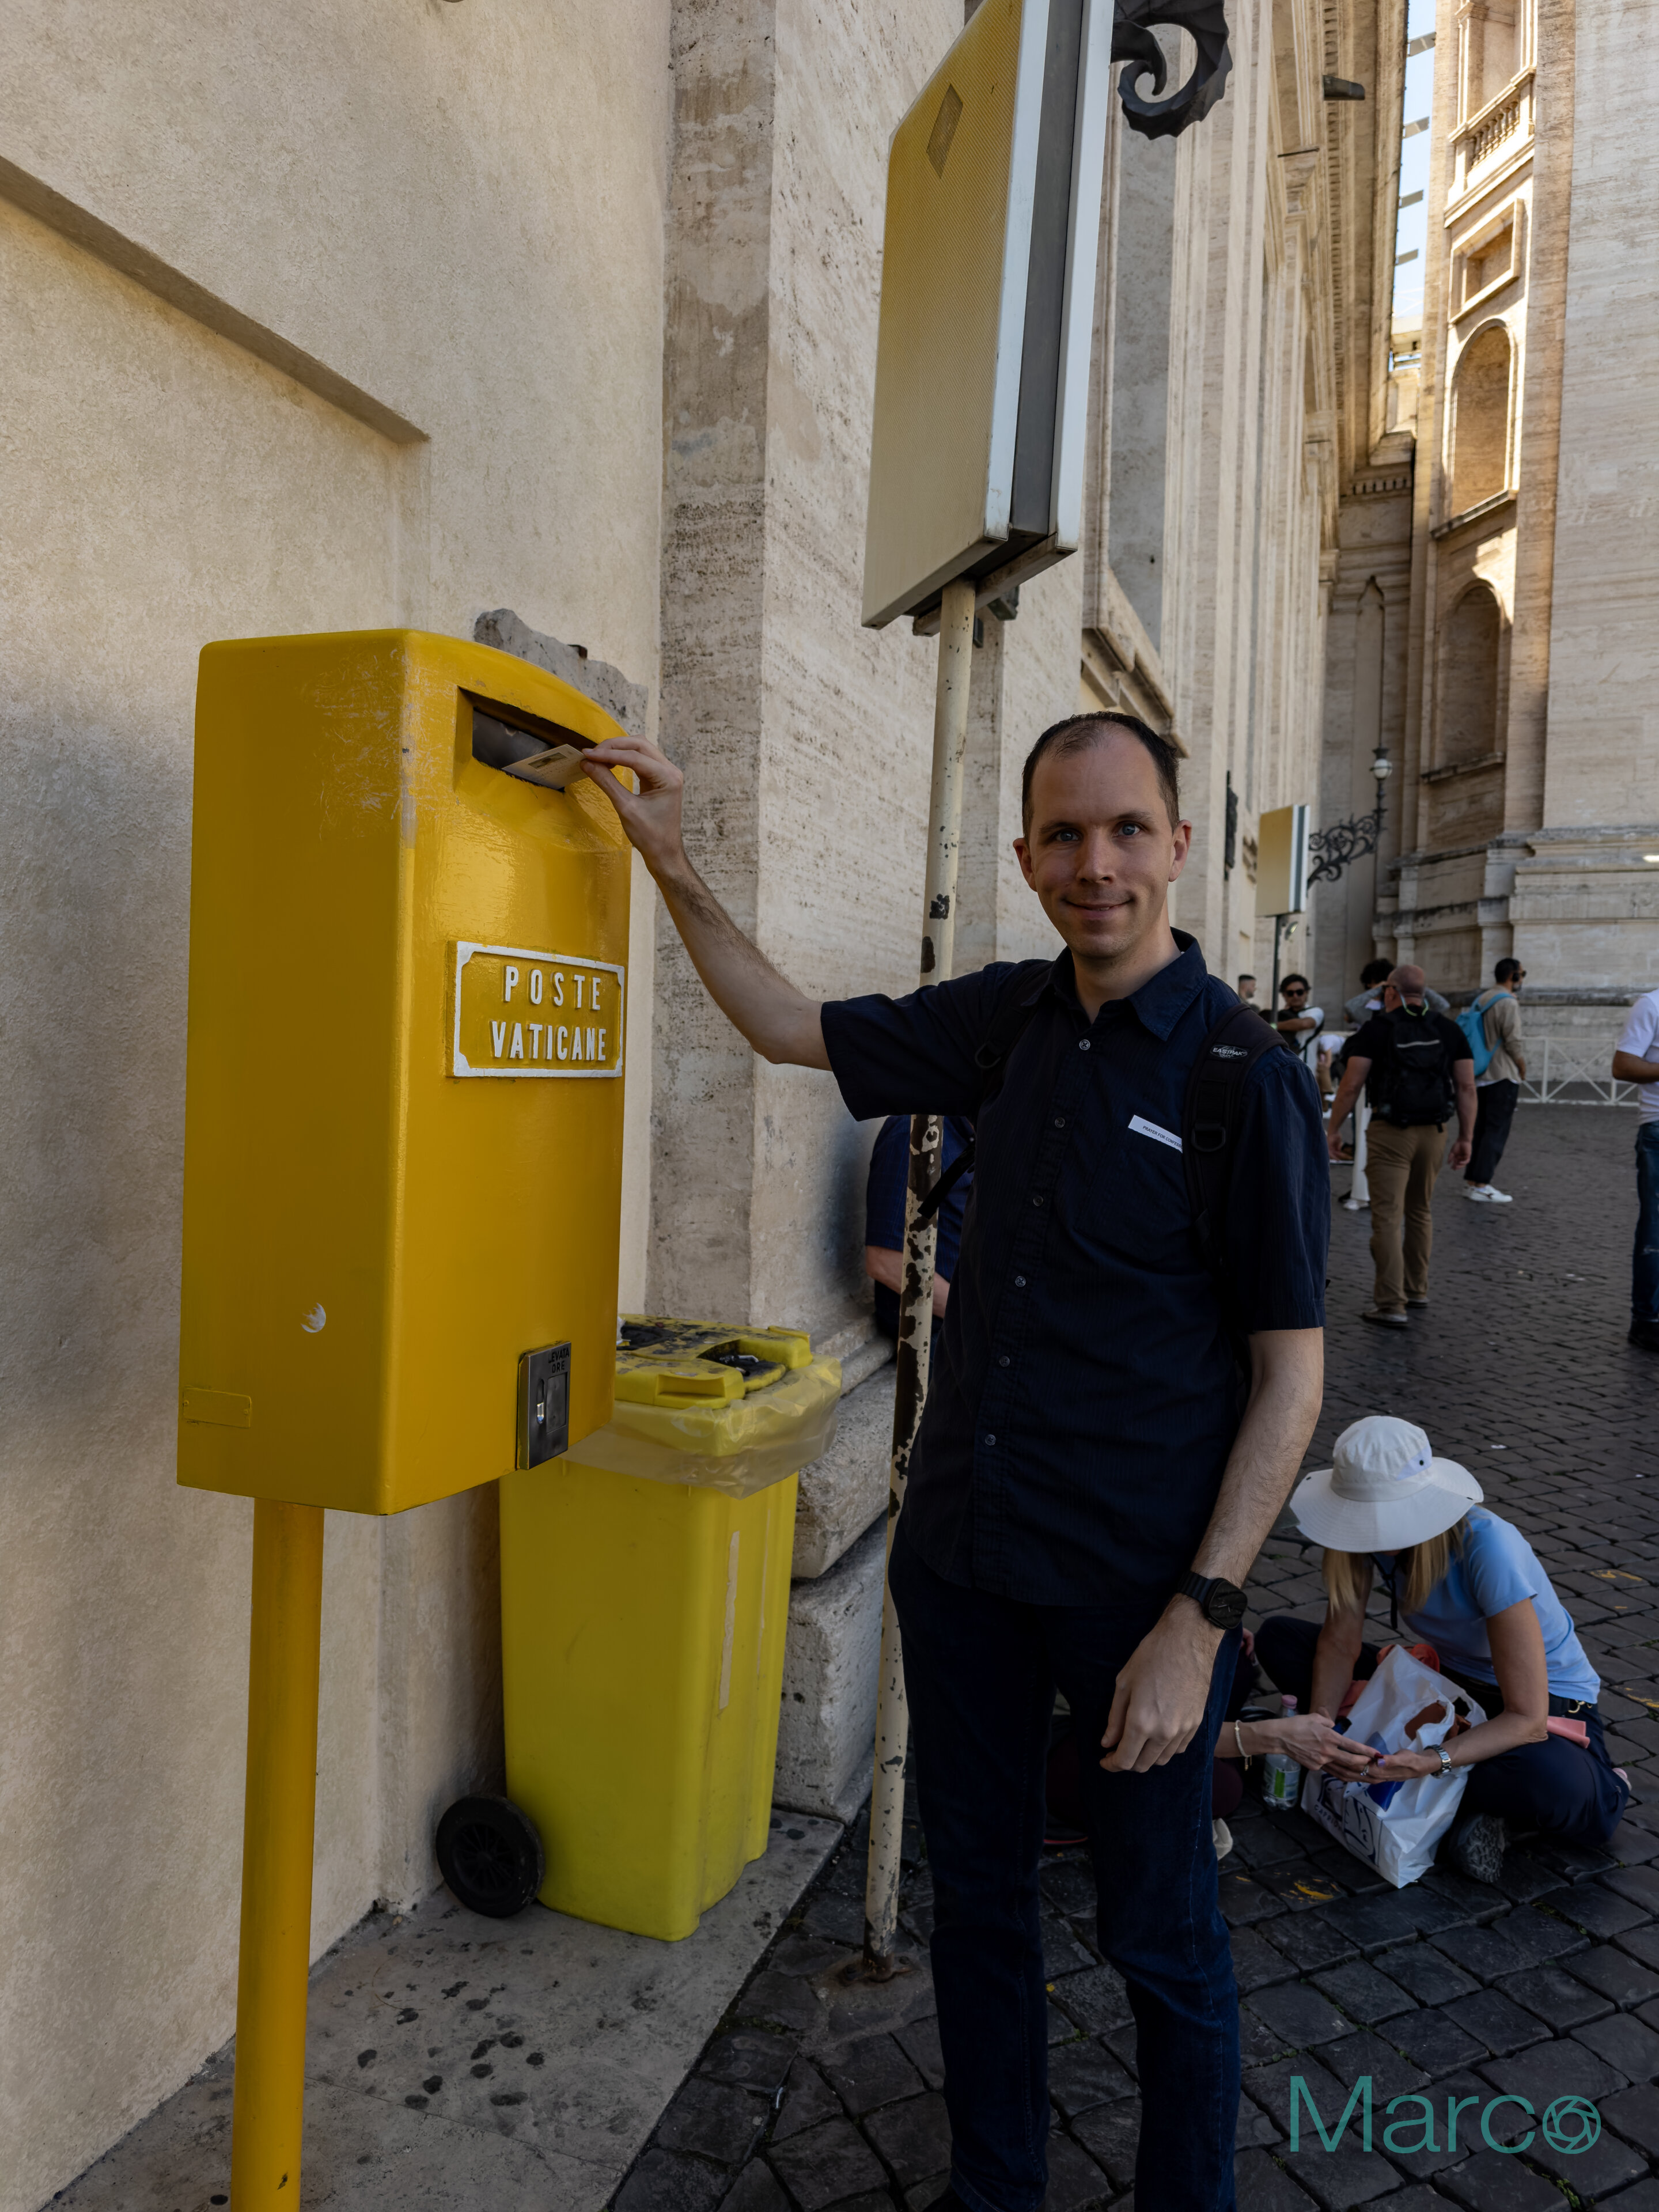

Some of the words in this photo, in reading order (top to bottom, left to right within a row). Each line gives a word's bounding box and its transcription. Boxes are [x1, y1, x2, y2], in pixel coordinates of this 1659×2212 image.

[505, 965, 601, 1010] POSTE
[491, 1021, 607, 1061] VATICANE
[1212, 1047, 1243, 1056] EASTPAK
[1142, 1126, 1158, 1136] PRAYER
[548, 1347, 570, 1364] LEVATA
[552, 1363, 565, 1374] ORE
